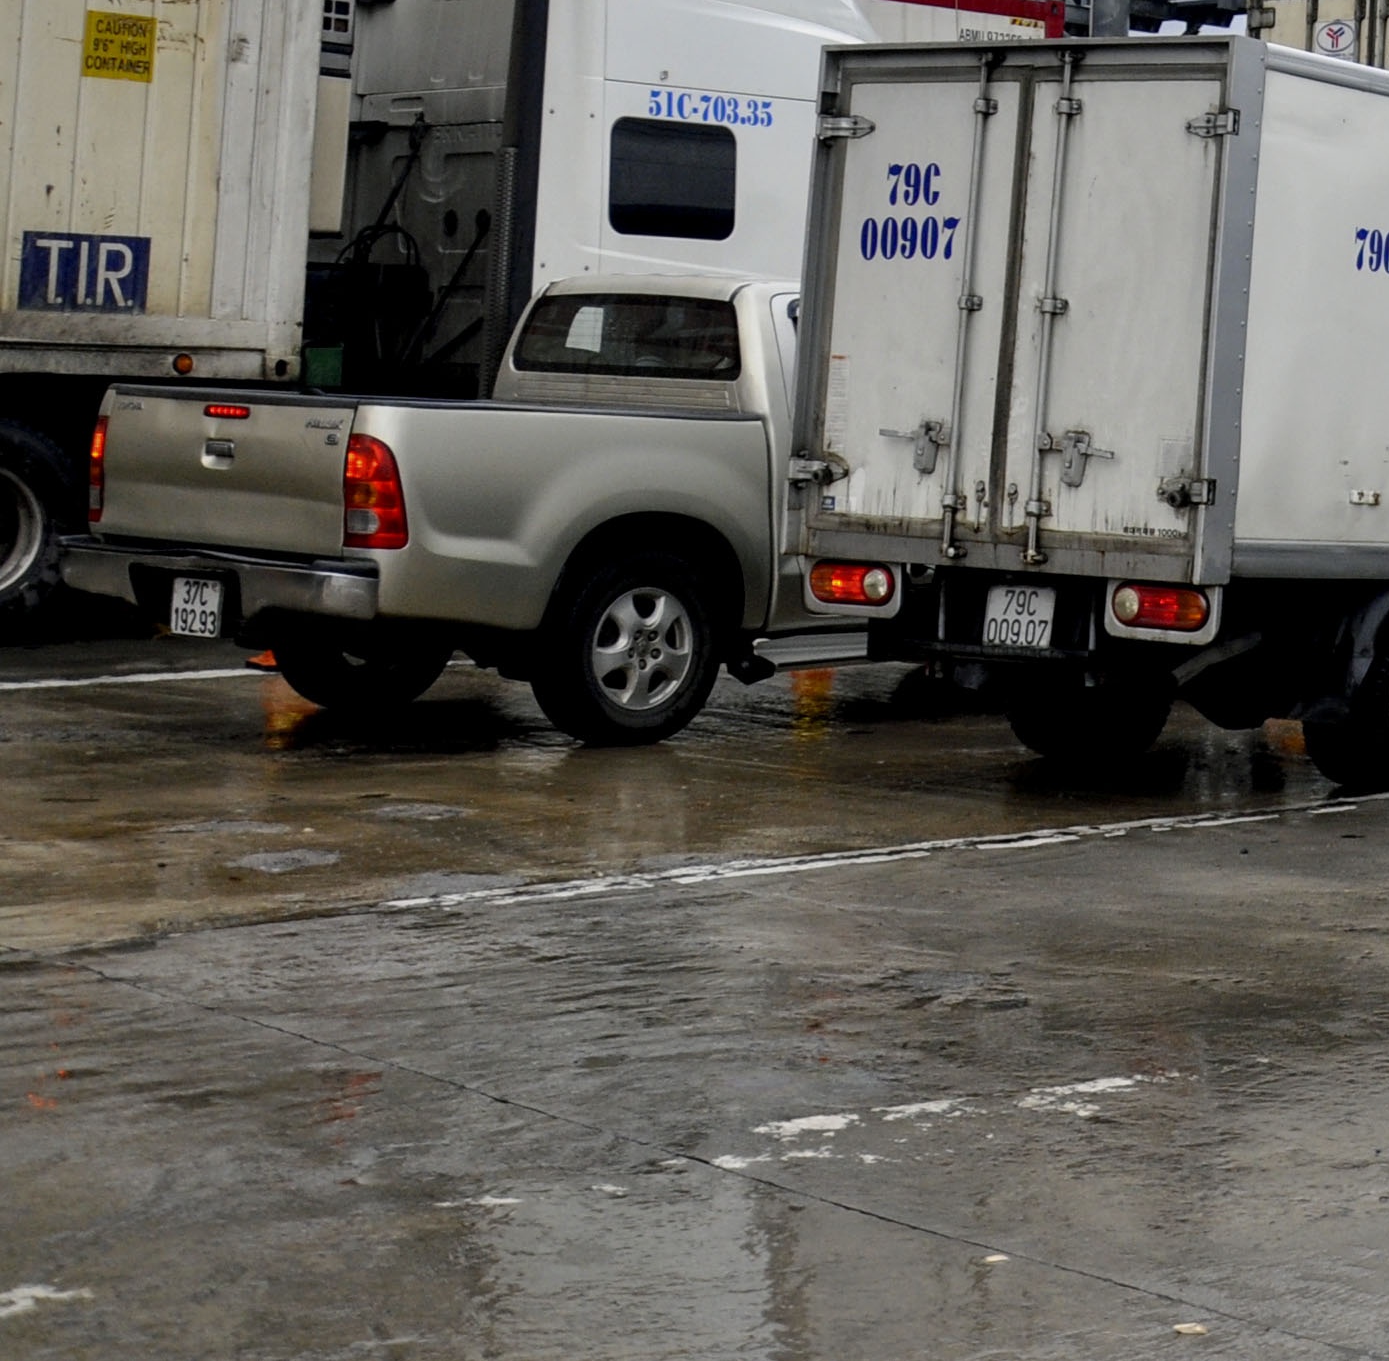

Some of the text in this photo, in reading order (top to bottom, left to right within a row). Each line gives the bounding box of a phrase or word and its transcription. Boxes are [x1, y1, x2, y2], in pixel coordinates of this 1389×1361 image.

[96, 19, 148, 38] CAUTION
[120, 41, 147, 56] HIGH
[85, 55, 150, 74] CONTAINER
[649, 90, 773, 127] 51C-703.35
[887, 162, 941, 206] 79C
[860, 216, 961, 260] 00907
[36, 240, 133, 307] T.I.R.
[183, 580, 209, 606] 37C
[1003, 589, 1039, 616] 79C
